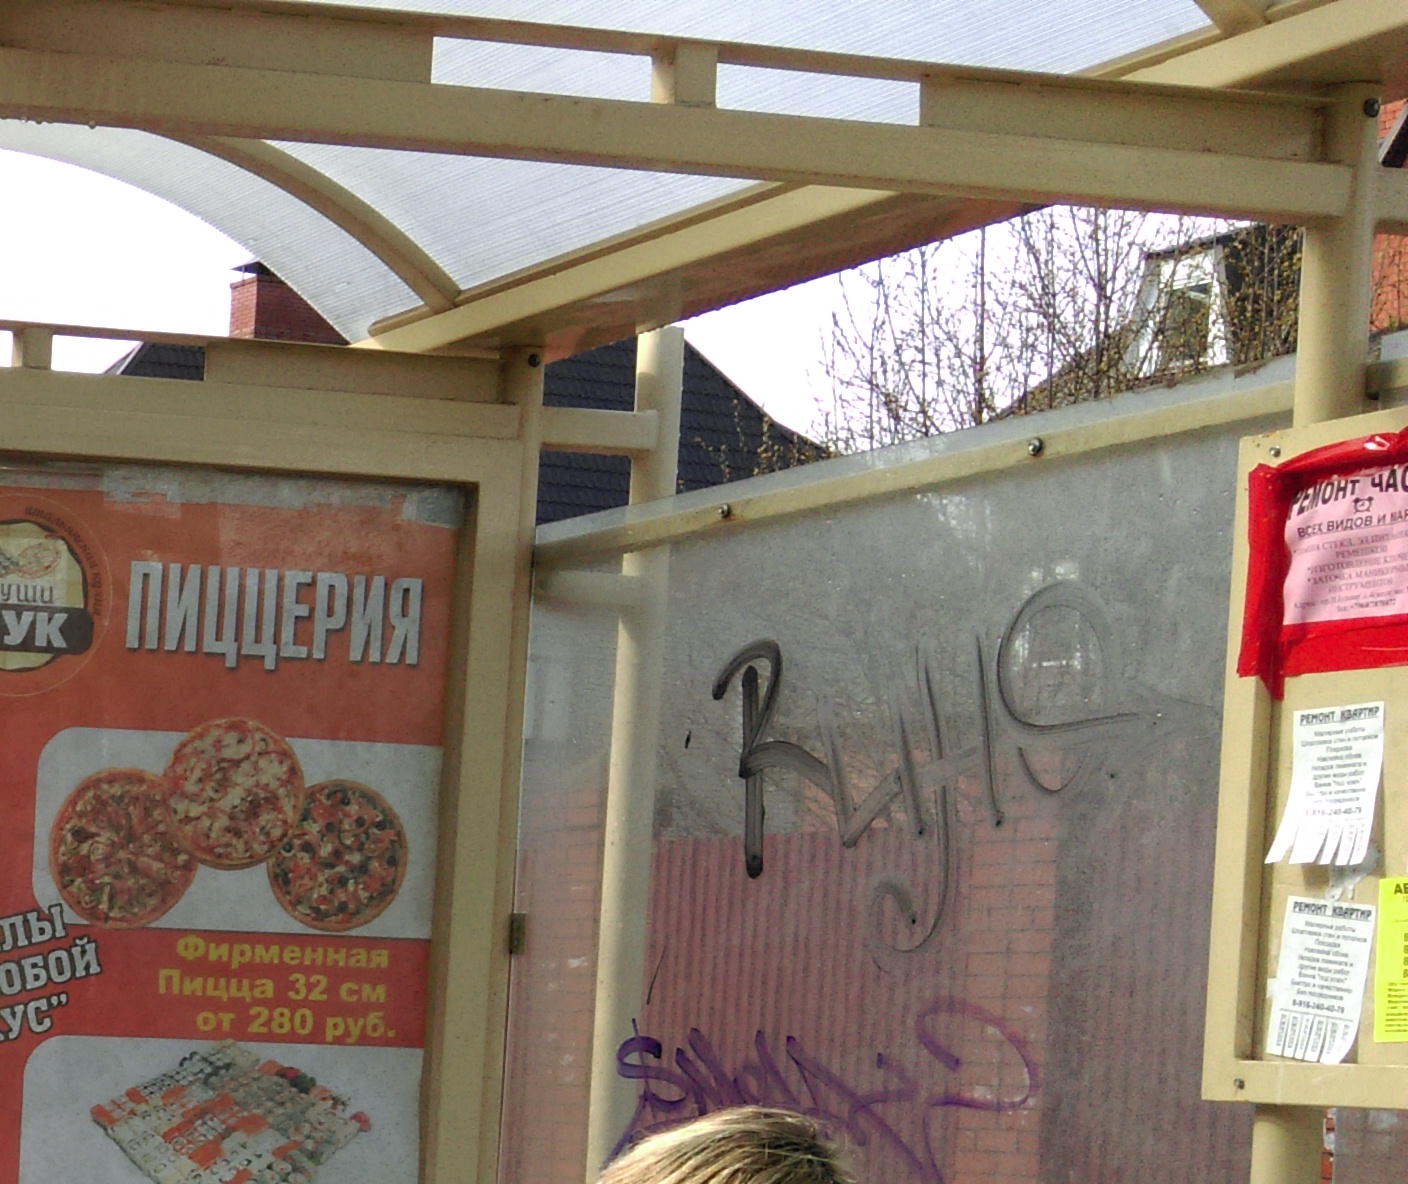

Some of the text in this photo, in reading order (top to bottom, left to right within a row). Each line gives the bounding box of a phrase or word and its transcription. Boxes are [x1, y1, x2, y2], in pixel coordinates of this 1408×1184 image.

[1287, 480, 1360, 520] РЕМОНТ
[1298, 522, 1324, 538] ВСЕХ
[1327, 516, 1372, 532] ВИДОВ
[126, 561, 422, 670] ПИЦЦЕРИЯ
[1300, 706, 1379, 725] РЕМОНТ КВАРТИР
[1293, 901, 1372, 920] РЕМОНТ КВАРТИР
[176, 934, 388, 968] Фирменная
[158, 969, 386, 1003] Пицца 32 см
[196, 1006, 396, 1043] от 280 руб.
